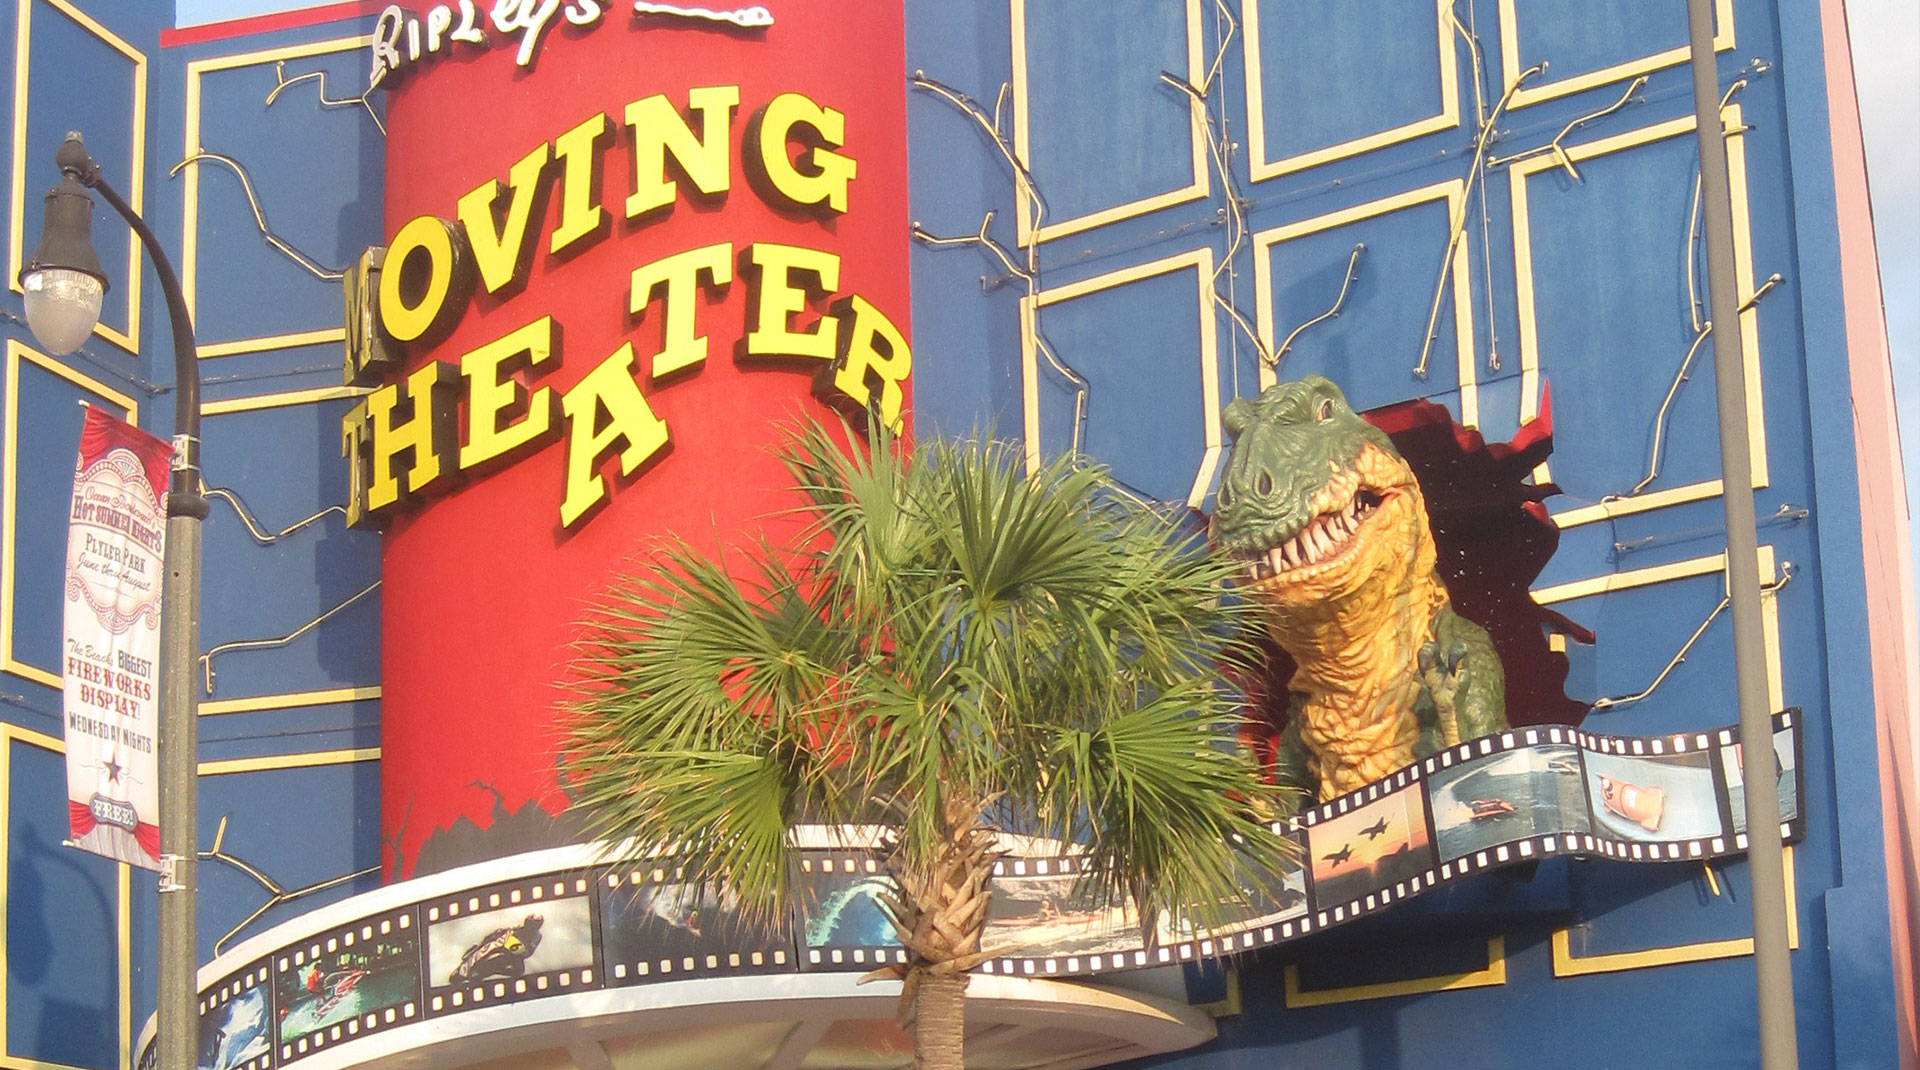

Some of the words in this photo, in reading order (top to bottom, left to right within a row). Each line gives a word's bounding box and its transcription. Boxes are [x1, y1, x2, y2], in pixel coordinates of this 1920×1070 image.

[343, 85, 857, 386] MOVING
[341, 241, 912, 529] THEATER
[77, 552, 99, 572] June
[121, 570, 151, 592] August
[122, 547, 146, 574] PARK
[67, 638, 84, 656] The
[118, 649, 152, 680] BIGGEST
[68, 656, 151, 702] FIREWORKS
[80, 683, 141, 721] DISPLAY!
[69, 711, 121, 746] WEDNESDAY
[123, 728, 152, 754] NIGHTS
[93, 799, 134, 826] FREE!
